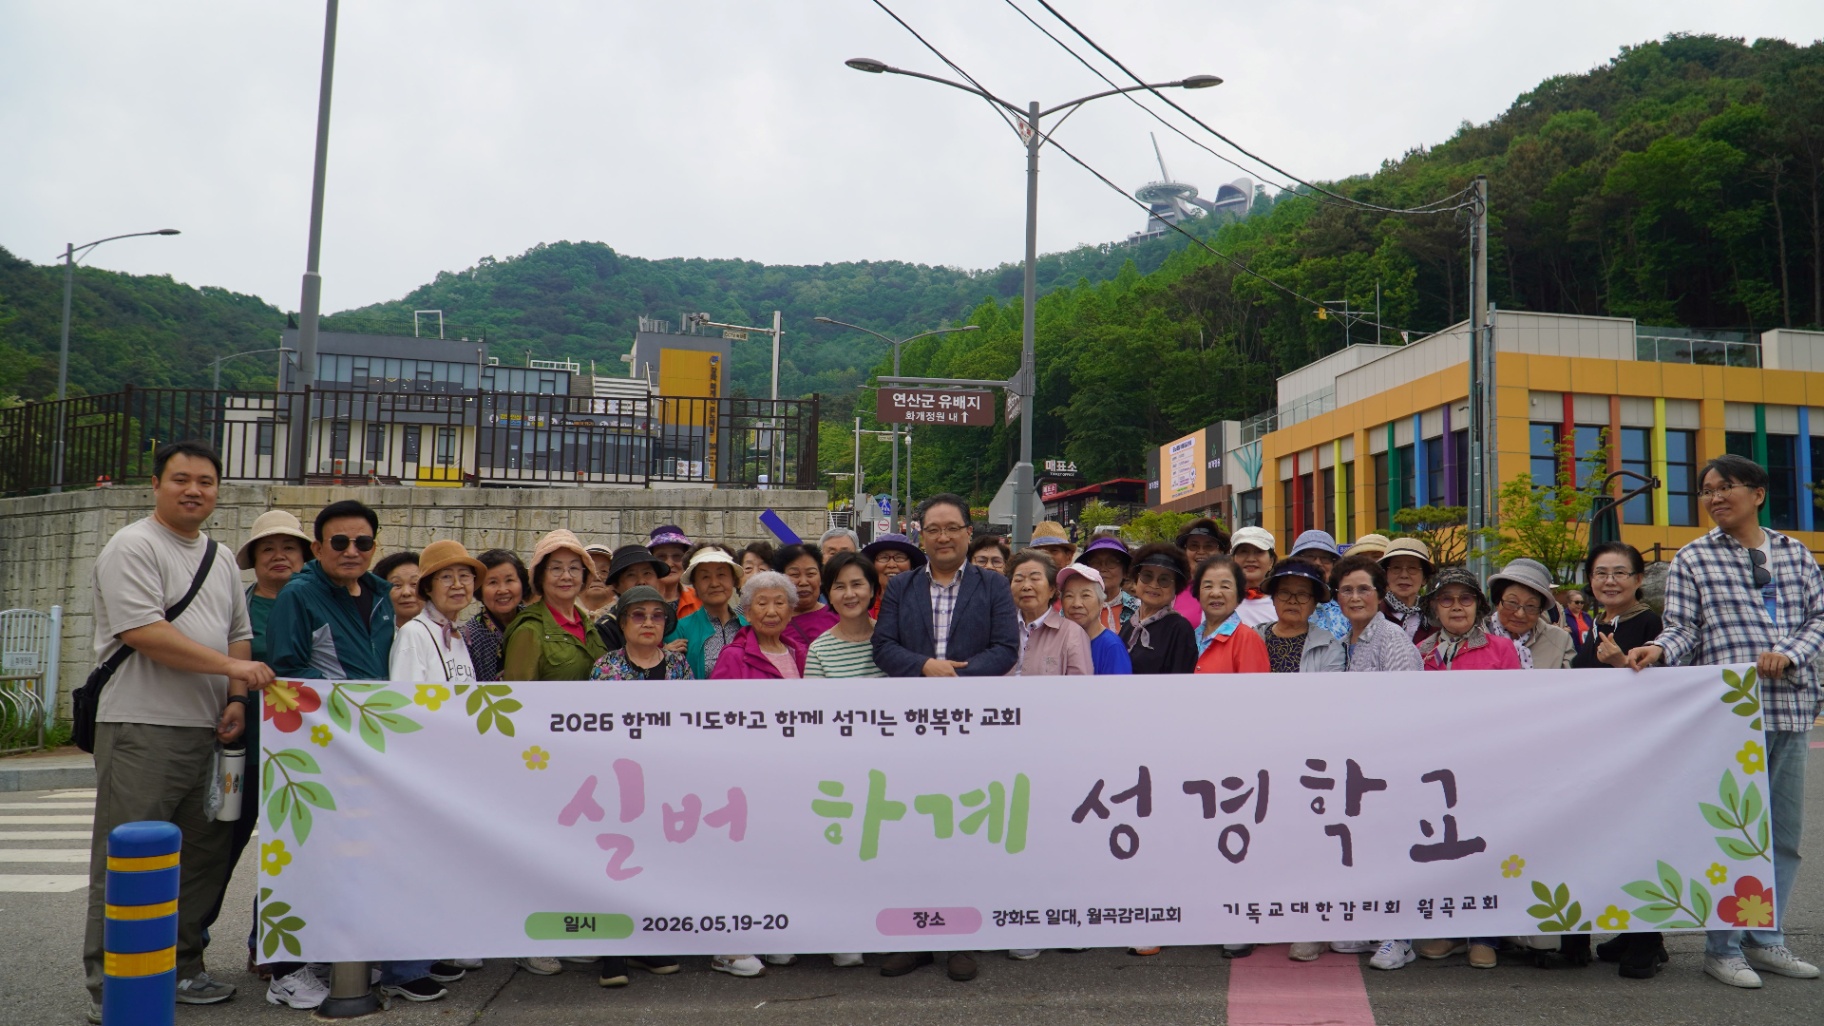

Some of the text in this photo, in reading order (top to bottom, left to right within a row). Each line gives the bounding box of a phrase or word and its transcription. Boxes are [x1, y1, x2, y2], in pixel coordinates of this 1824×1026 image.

[892, 392, 981, 410] 연산군 유배지
[905, 411, 959, 423] 화개정원 내
[1045, 460, 1078, 472] 매표소
[550, 707, 1022, 740] 2026 함께 기도하고 함께 섬기는 행복한 교회
[557, 758, 748, 881] 실버
[811, 768, 1031, 862] 하계
[912, 906, 1182, 929] 장소 강화도 일대, 월곡감리교회
[1223, 894, 1499, 925] 기독교대한감리회 월곡교회
[563, 913, 790, 935] 일시 2026.05.19-20
